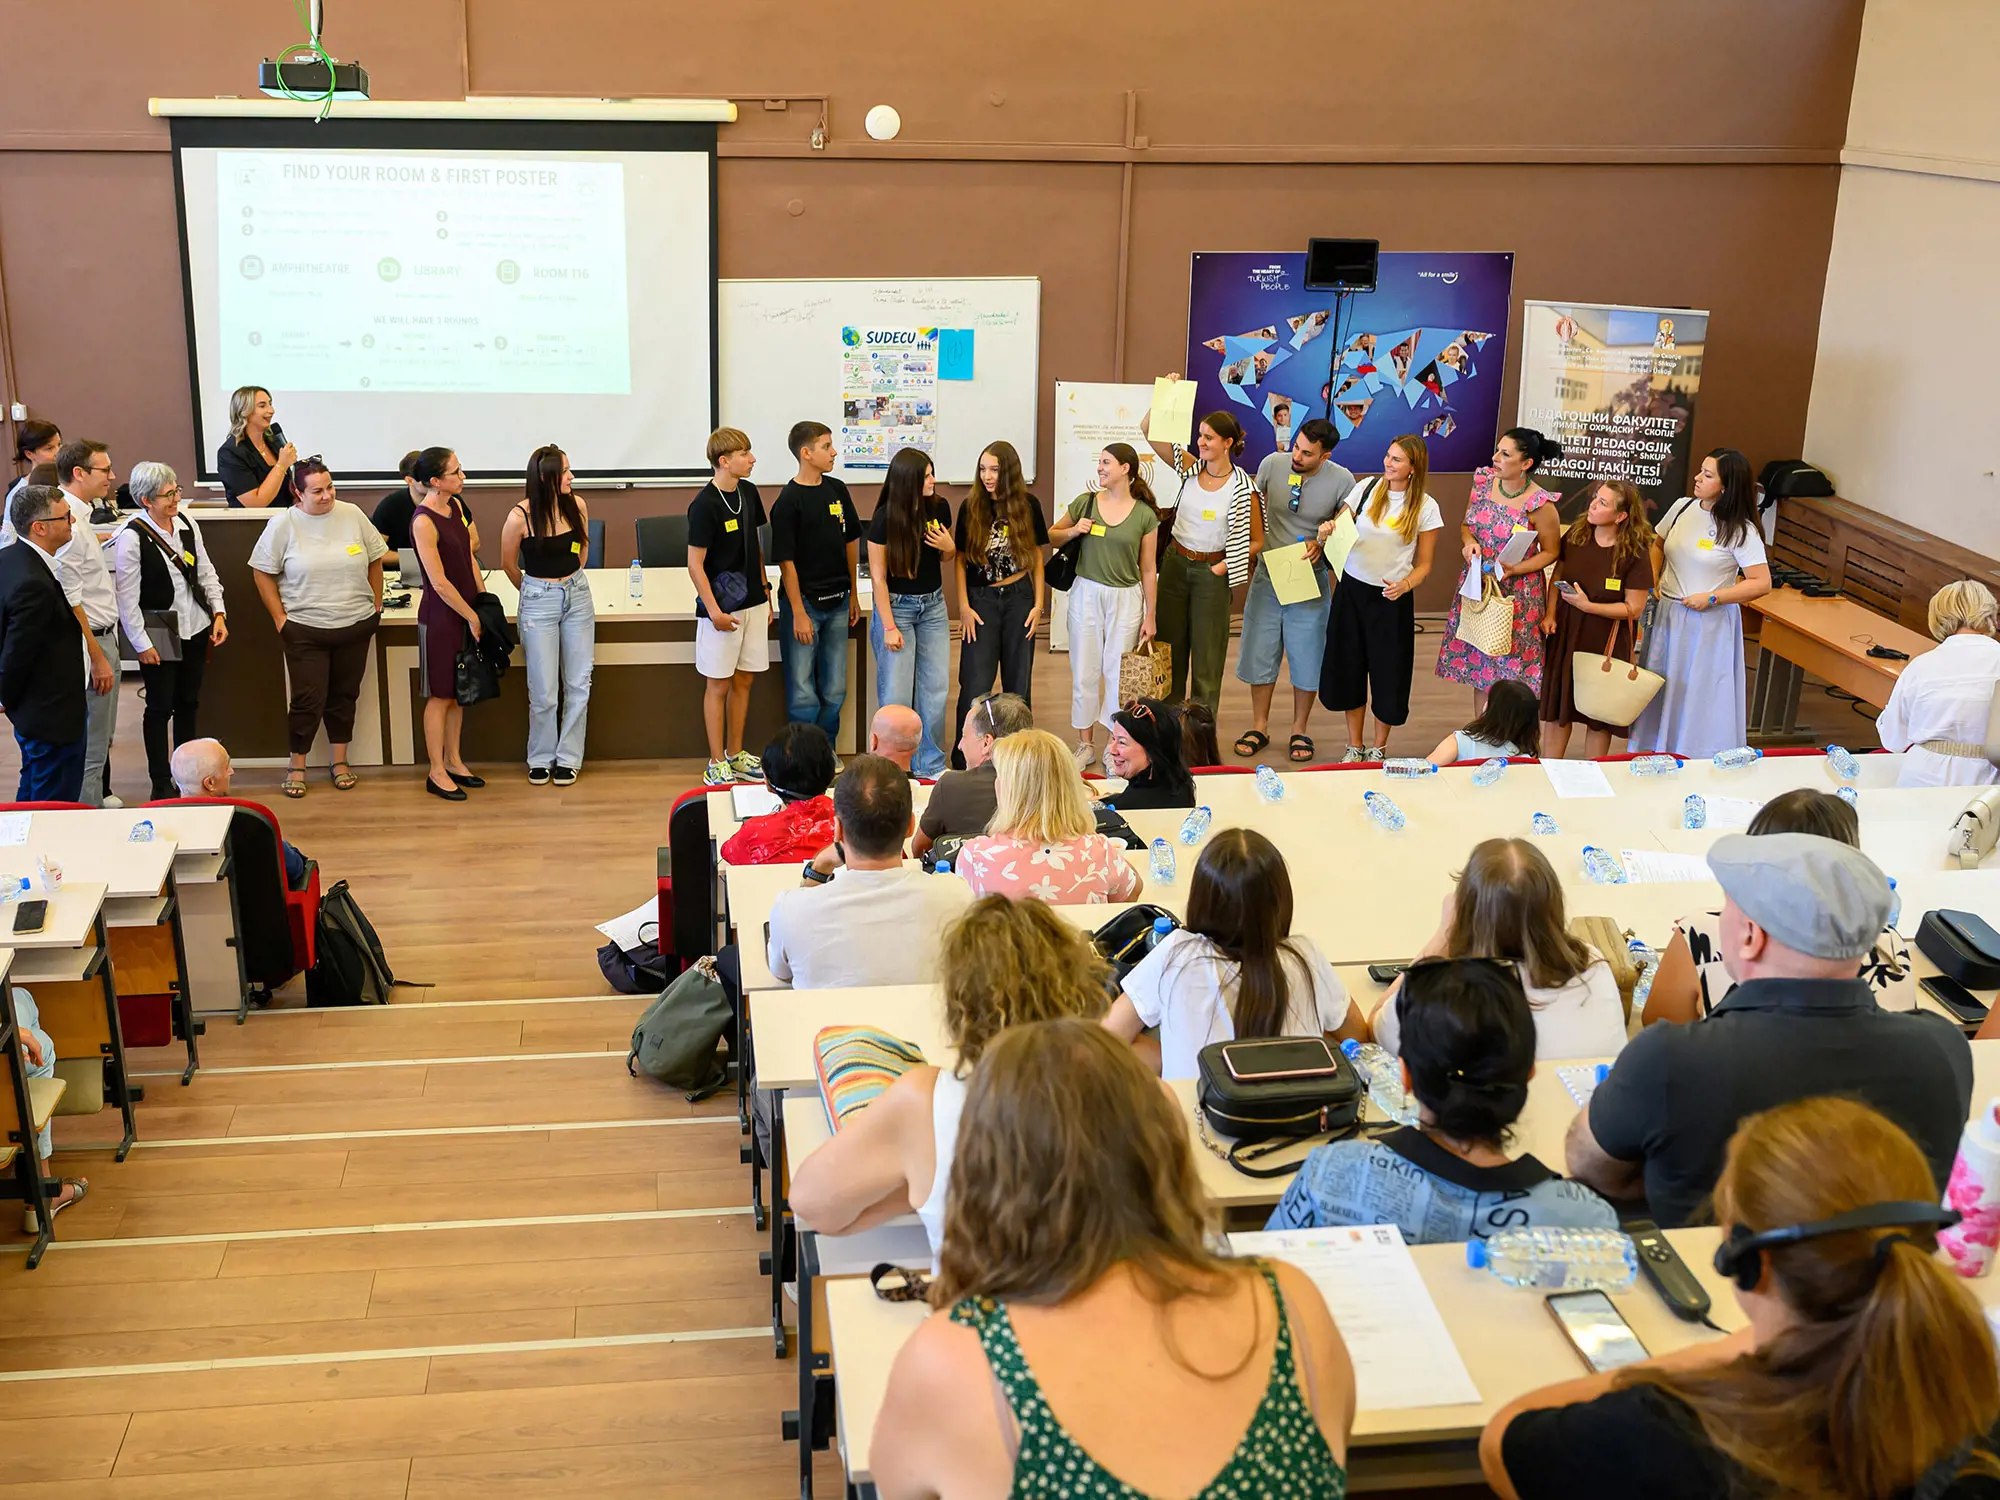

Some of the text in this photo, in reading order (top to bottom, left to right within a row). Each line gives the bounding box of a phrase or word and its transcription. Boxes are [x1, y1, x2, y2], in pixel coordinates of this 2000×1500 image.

[283, 164, 558, 186] FIND YOUR ROOM & FIRST POSTER
[271, 263, 351, 275] AMPHITHEATRE
[413, 264, 462, 277] LIBRARY
[533, 267, 568, 279] ROOM
[1248, 274, 1280, 282] TURKISH
[1260, 283, 1290, 291] PEOPLE
[373, 316, 388, 325] WE
[390, 316, 410, 325] WILL
[412, 316, 434, 325] HAVE
[444, 317, 479, 326] ROUNDS
[866, 331, 916, 344] SUDECU
[1658, 360, 1677, 369] Shkup
[1530, 408, 1678, 430] ПЕДАГОШКИ ФАКУЛТЕТ
[1589, 423, 1634, 434] ОХРИДСКИ
[1644, 428, 1675, 438] СКОПЈЕ
[1561, 446, 1590, 455] LIMENT
[1592, 448, 1630, 458] OHRIDSKI
[1594, 437, 1672, 454] PEDAGOGJIK
[1542, 456, 1660, 477] EDAGOJİ FAKÜLTESİ
[1534, 467, 1549, 476] AYA
[1635, 476, 1662, 487] ÜSKÜP
[1279, 559, 1301, 584] 2
